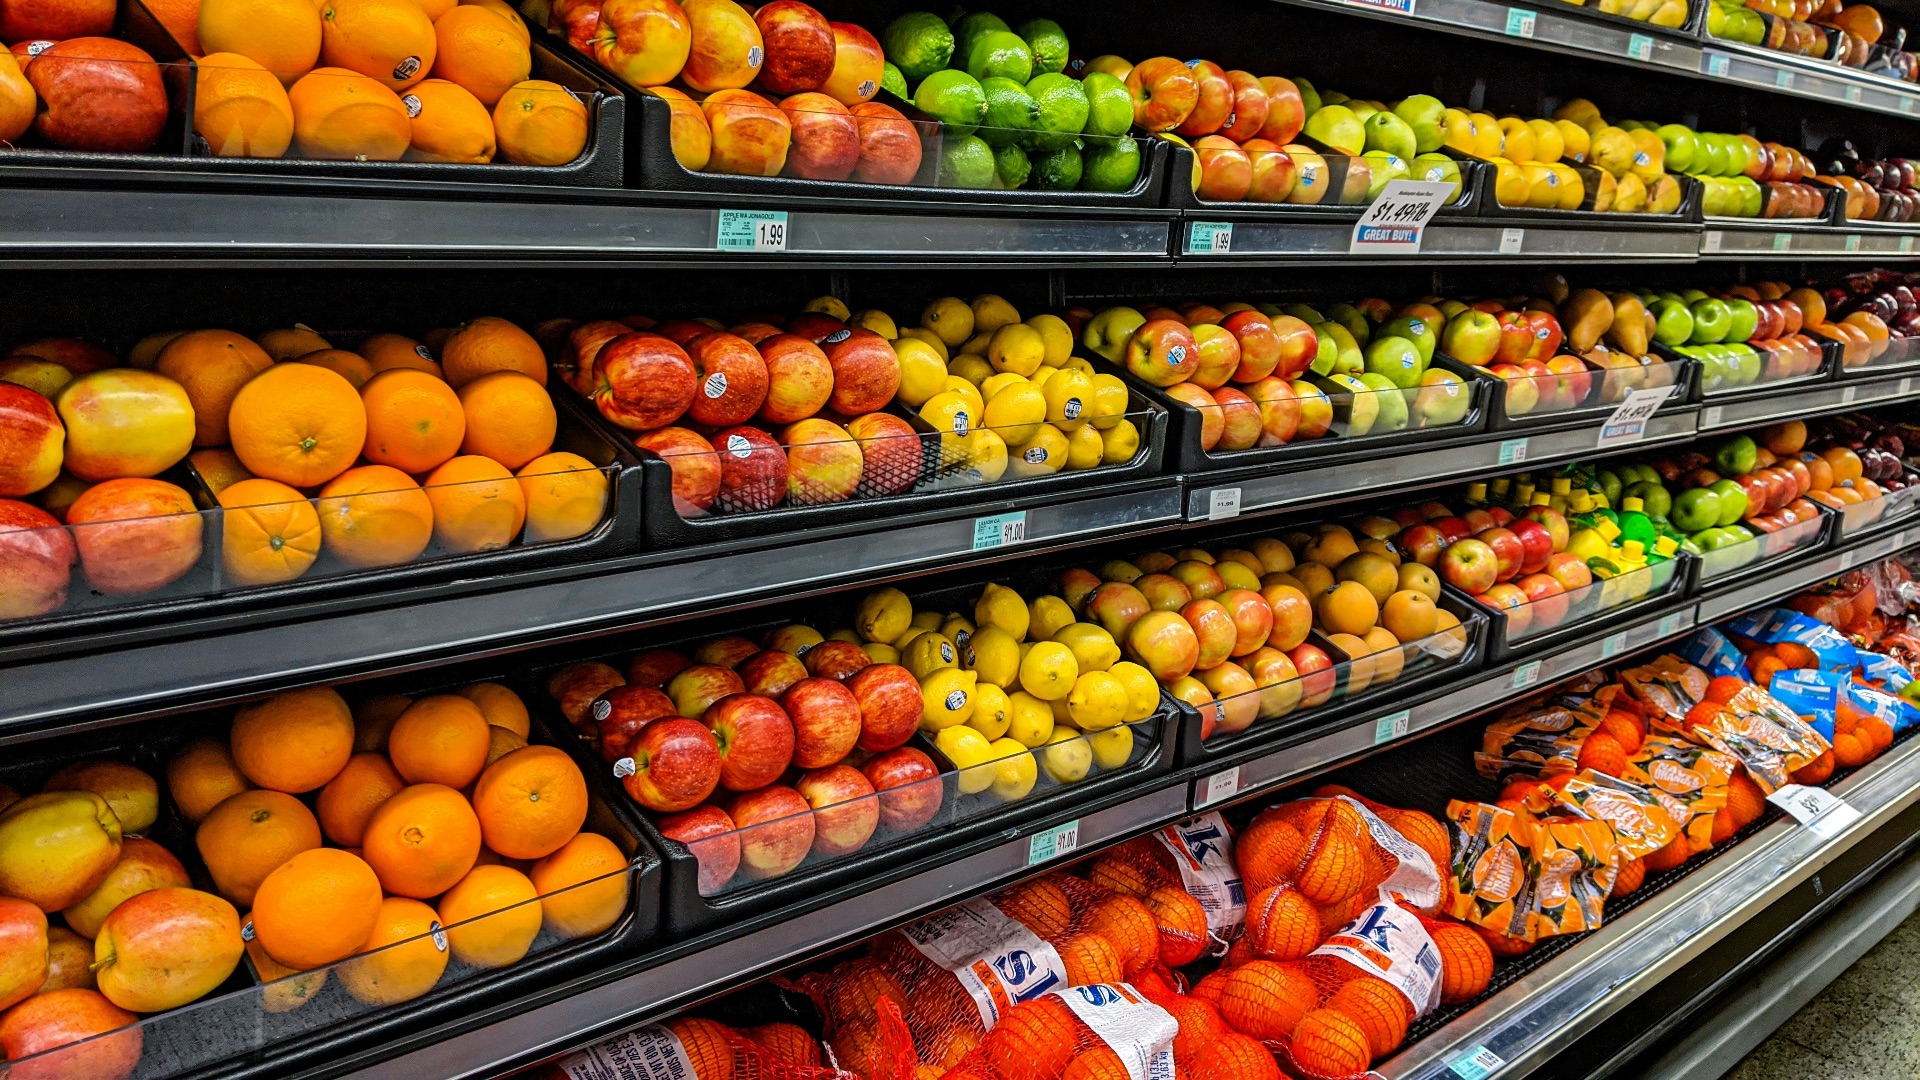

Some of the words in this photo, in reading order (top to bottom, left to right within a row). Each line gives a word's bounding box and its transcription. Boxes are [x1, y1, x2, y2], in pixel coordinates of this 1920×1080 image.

[760, 223, 783, 246] 1.99
[1215, 232, 1229, 250] 1.99
[1363, 228, 1391, 241] GREAT
[1393, 229, 1413, 241] BUY!
[1330, 937, 1383, 963] RANGES
[982, 970, 1010, 1011] ORAN
[626, 1047, 641, 1061] DES
[643, 1045, 659, 1060] 8lb
[659, 1043, 676, 1059] NET
[1159, 1051, 1169, 1060] kg
[613, 1054, 627, 1066] OF
[649, 1058, 665, 1074] WT
[666, 1056, 686, 1080] POIDS
[1160, 1061, 1169, 1079] 3.63
